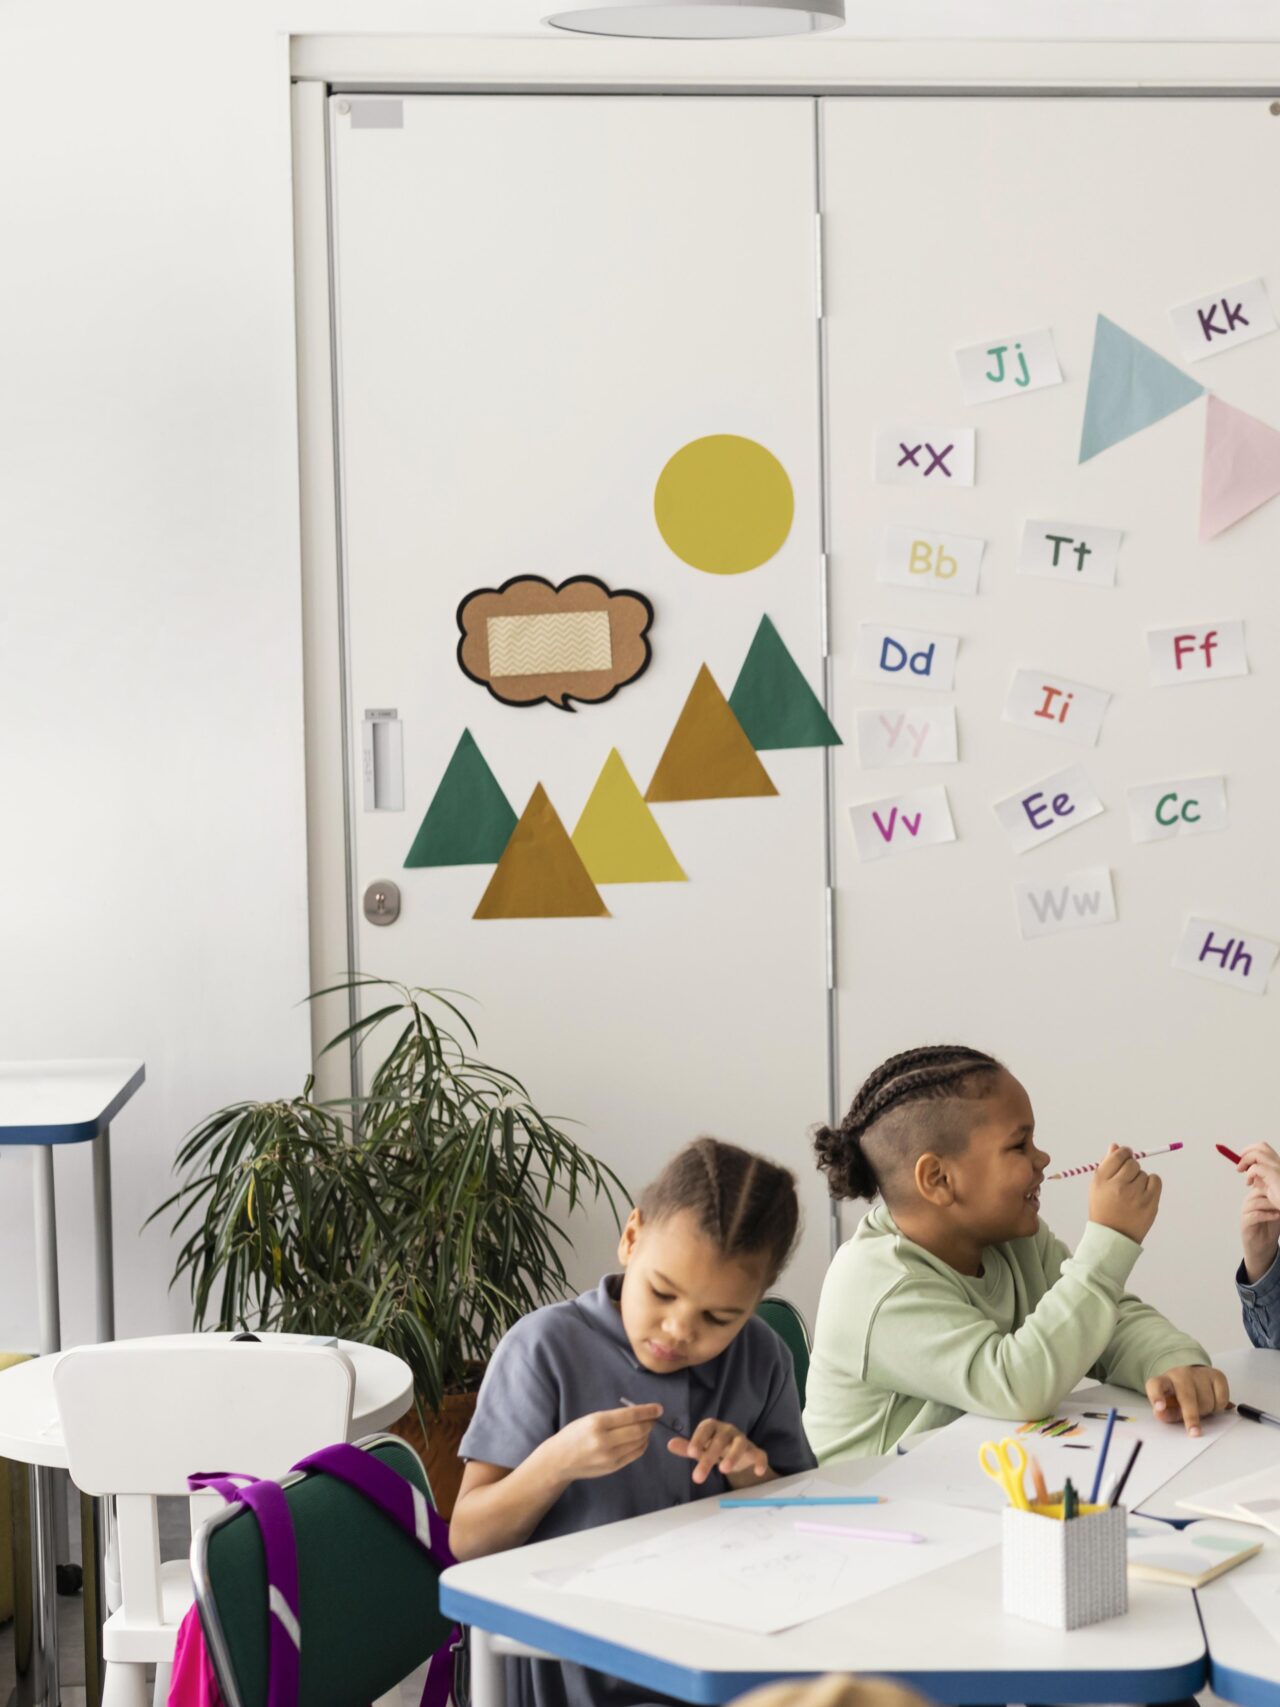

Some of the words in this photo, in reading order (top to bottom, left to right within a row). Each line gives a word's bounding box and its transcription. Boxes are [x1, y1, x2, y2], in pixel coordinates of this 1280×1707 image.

[1197, 299, 1249, 341] Kk
[986, 343, 1030, 387] Jj
[909, 540, 957, 579] Bb
[1045, 534, 1091, 571] Tt
[880, 637, 935, 676] Dd
[1174, 631, 1217, 670] Ff
[1034, 686, 1073, 723] Ii
[879, 713, 930, 758] Yy
[872, 807, 921, 842] Vv
[1022, 792, 1075, 830] Ee
[1155, 793, 1200, 826] Cc
[1028, 887, 1099, 922] Ww
[1199, 932, 1252, 976] Hh
